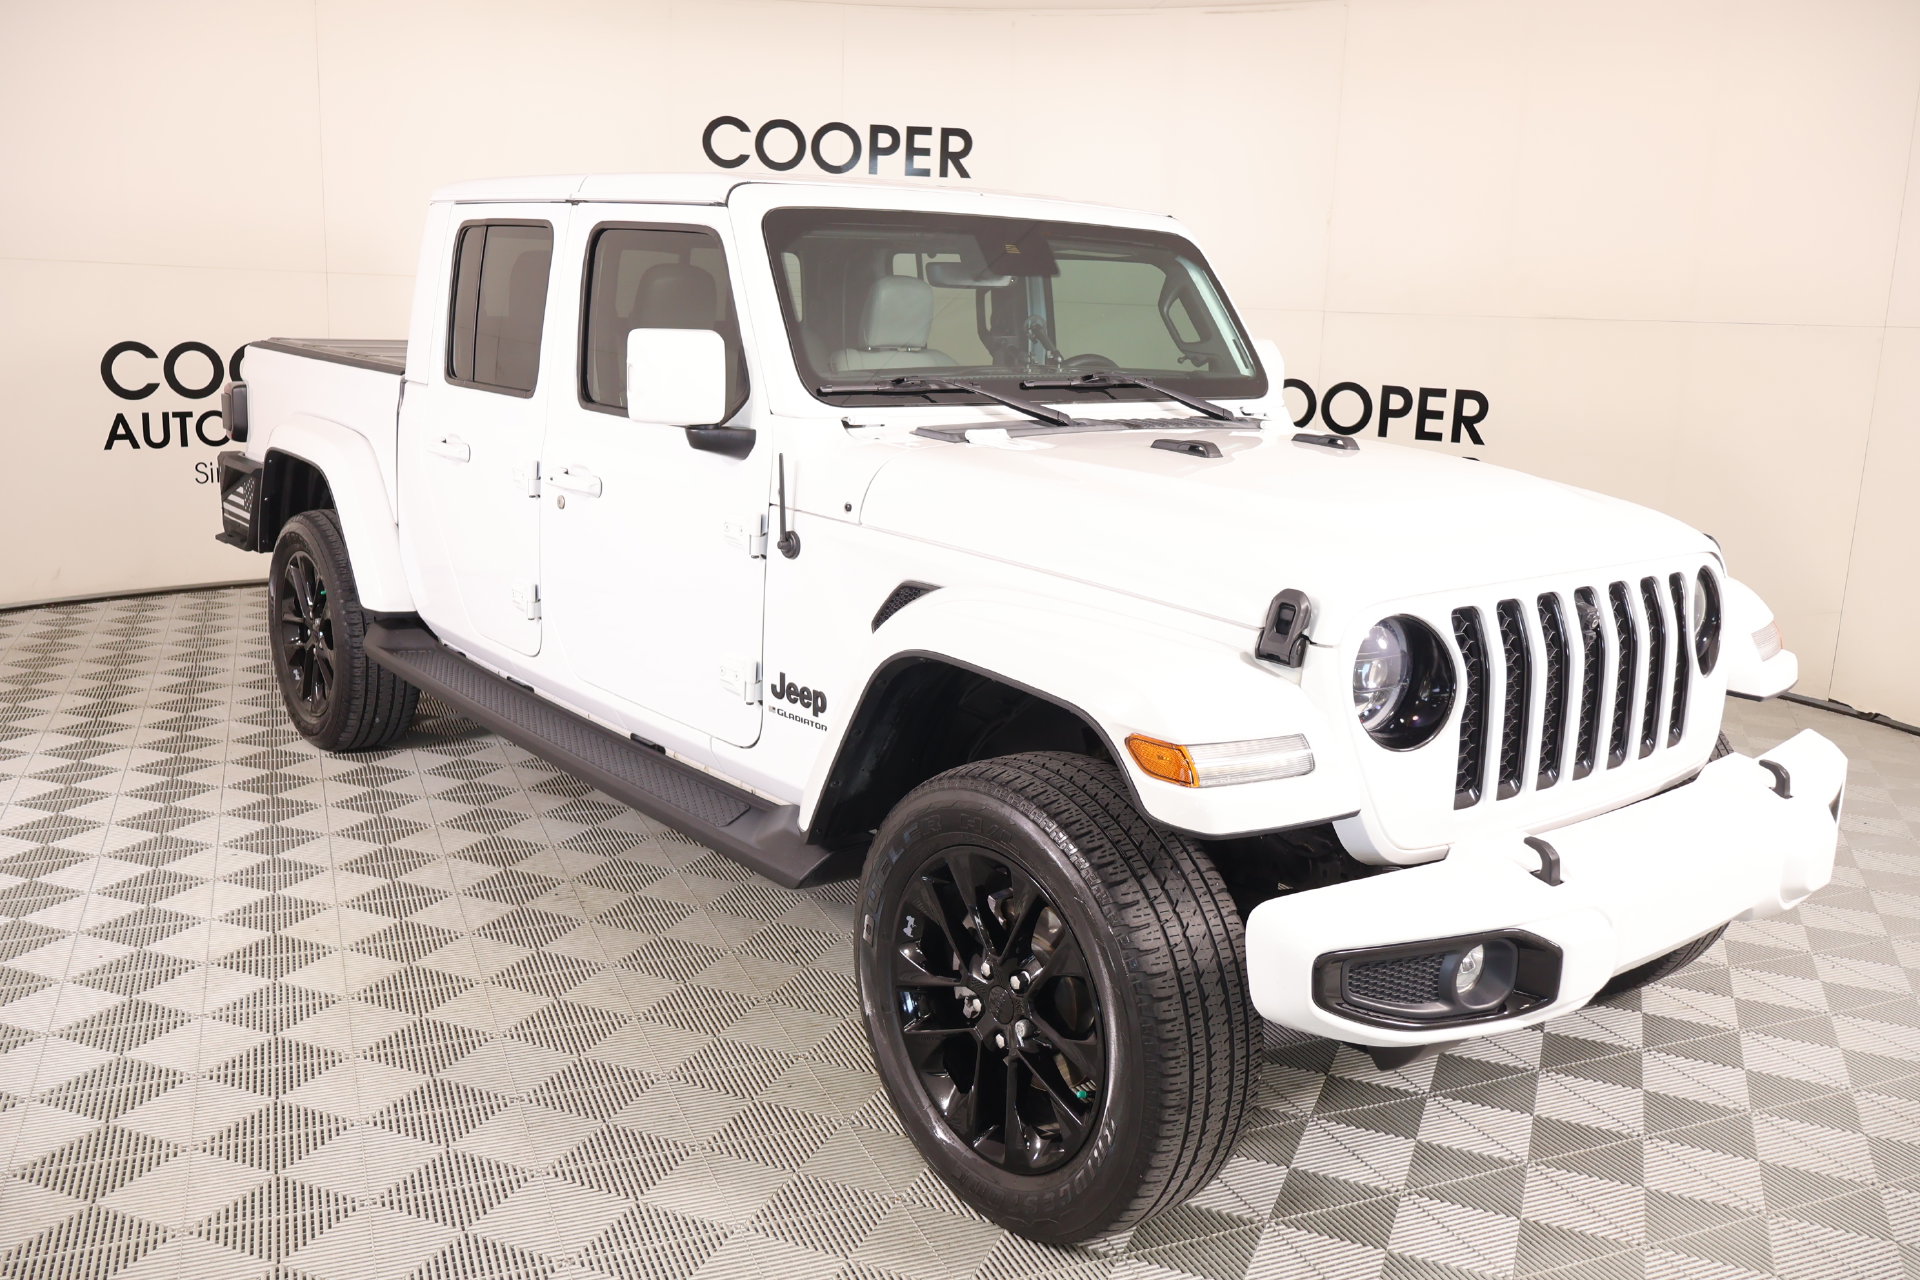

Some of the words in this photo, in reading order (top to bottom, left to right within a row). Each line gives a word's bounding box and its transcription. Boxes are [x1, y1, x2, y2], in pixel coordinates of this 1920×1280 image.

[702, 115, 973, 178] COOPER
[1283, 378, 1489, 445] OOPER
[770, 671, 828, 718] Jeep
[776, 708, 828, 732] GLADIATOR
